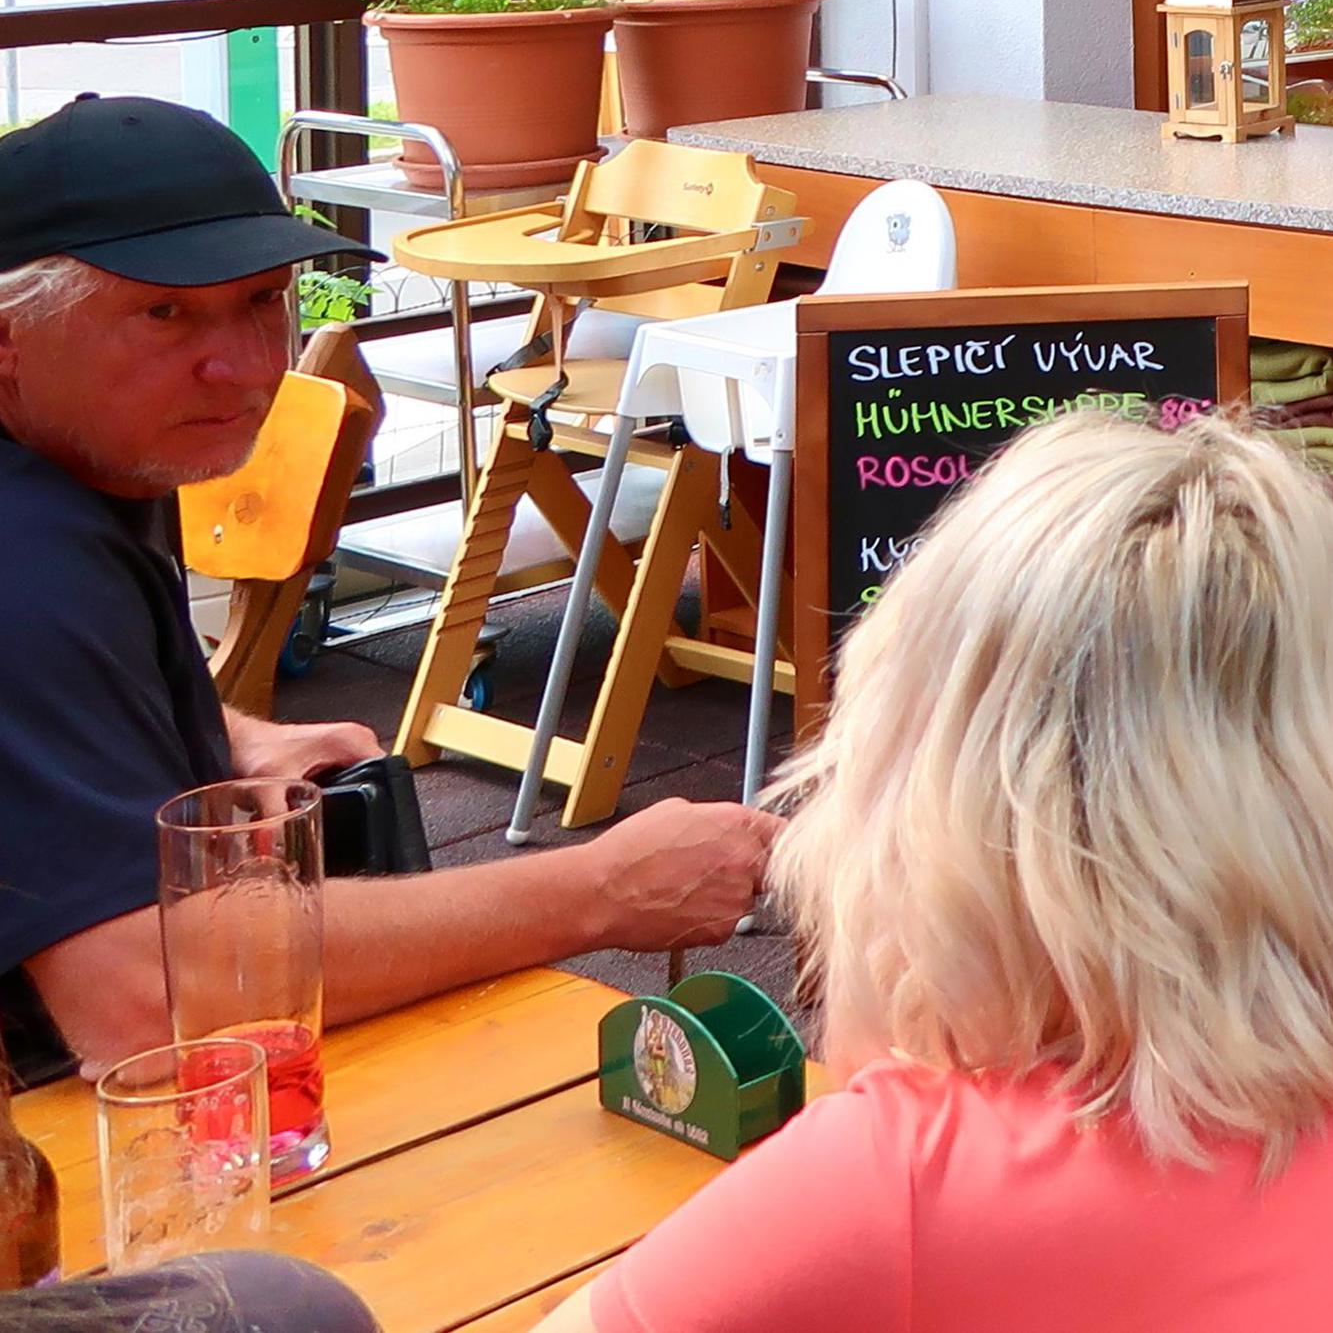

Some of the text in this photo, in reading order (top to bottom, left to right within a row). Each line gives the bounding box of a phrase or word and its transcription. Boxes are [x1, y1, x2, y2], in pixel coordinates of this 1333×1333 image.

[848, 331, 1164, 381] SLEPIČÍ VÝVAR
[855, 388, 1147, 439] HÜHNERSUPPE
